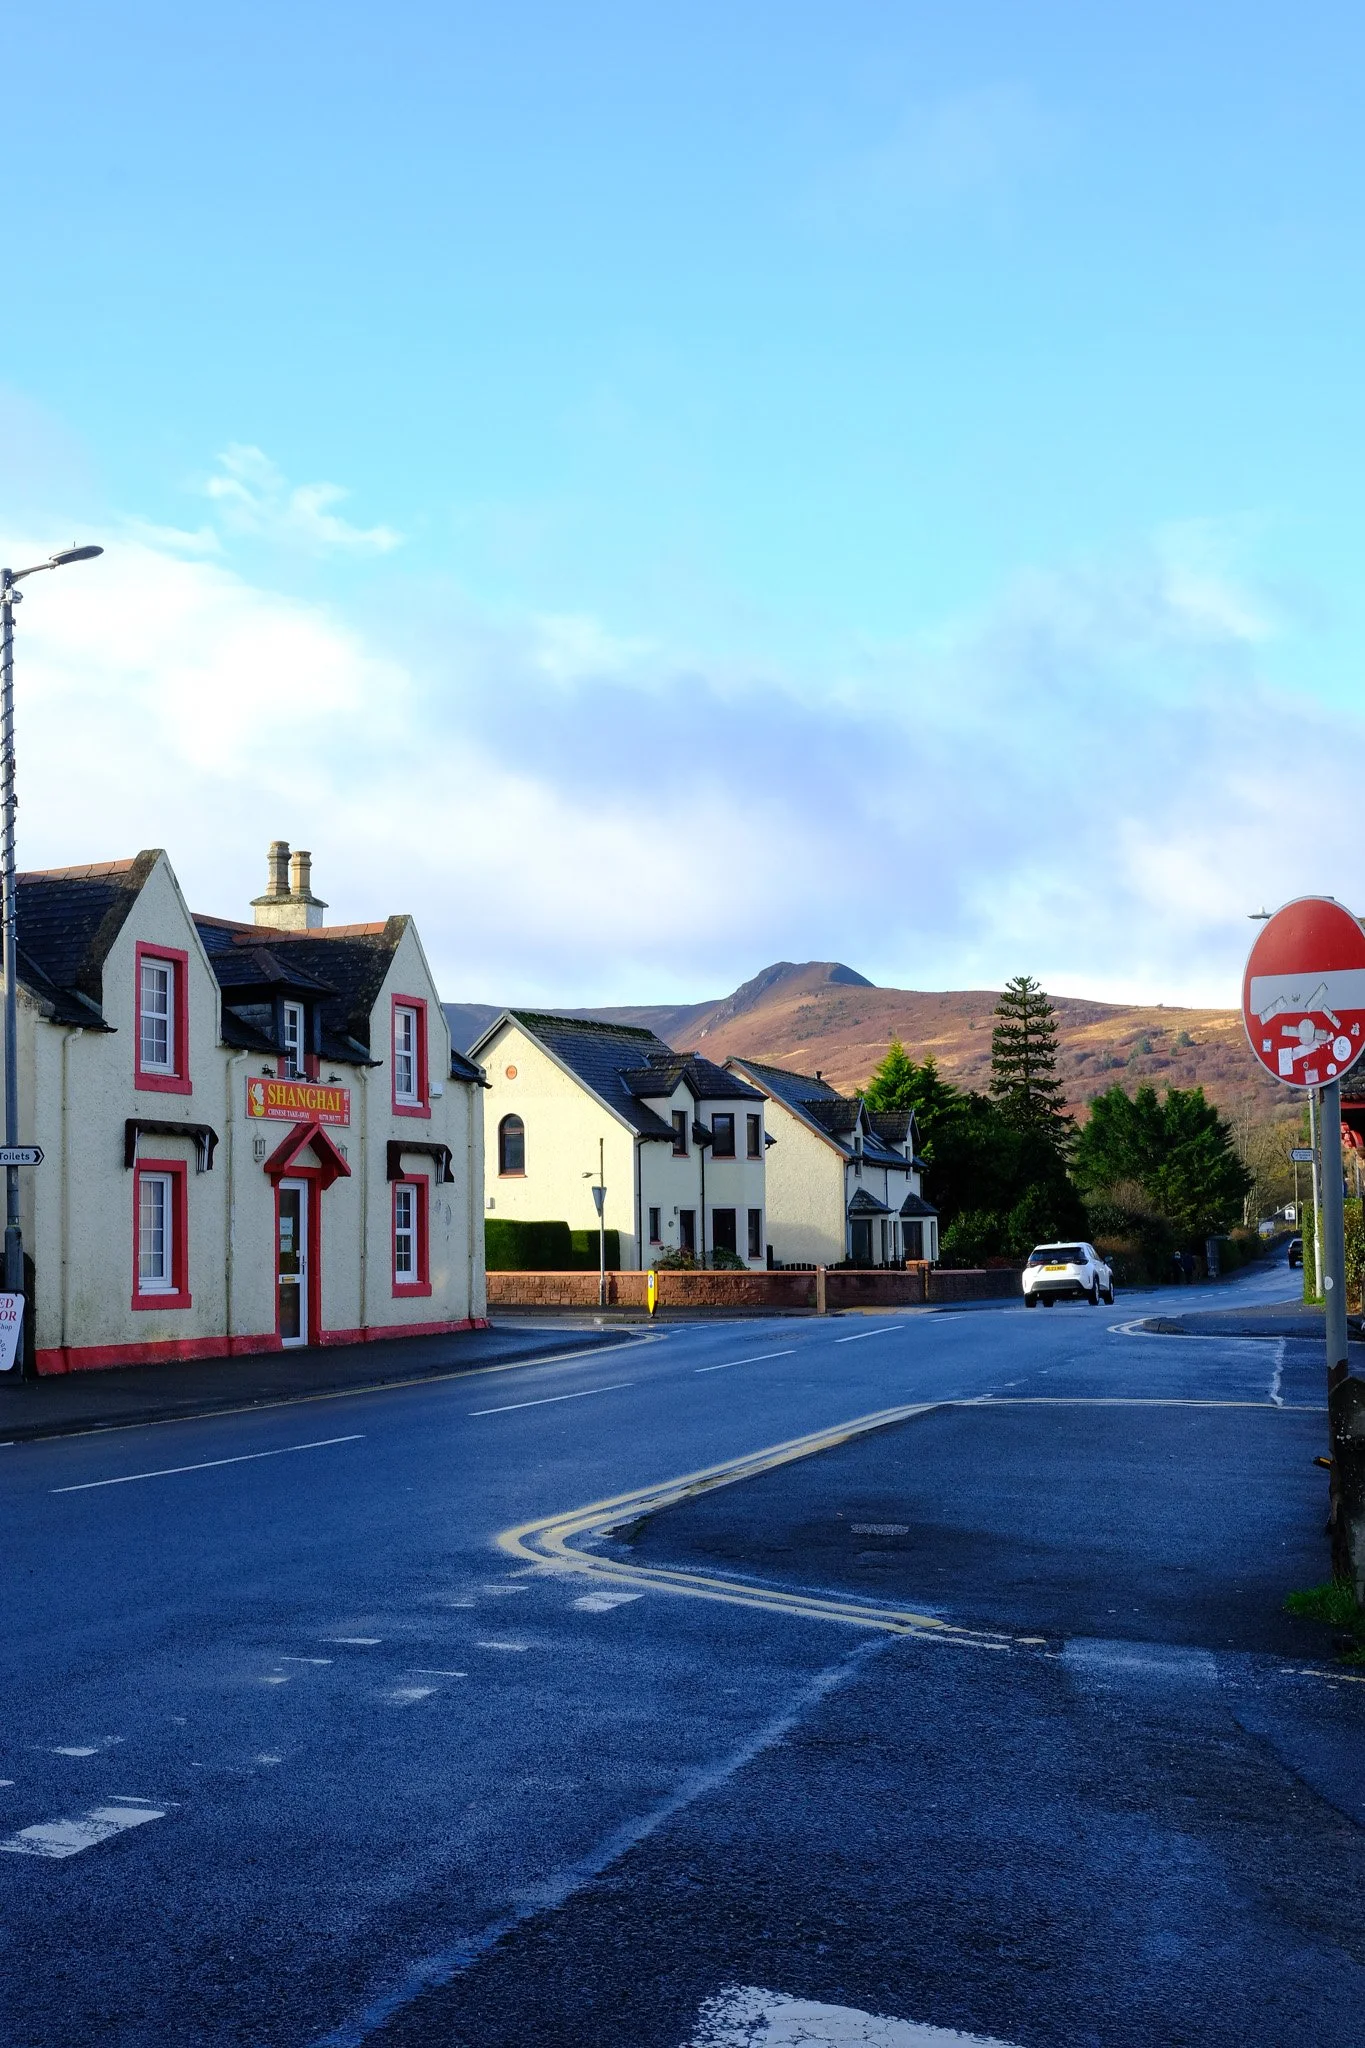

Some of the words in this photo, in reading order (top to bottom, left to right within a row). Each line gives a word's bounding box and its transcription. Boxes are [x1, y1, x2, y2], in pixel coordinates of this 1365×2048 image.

[268, 1083, 341, 1112] SHANGHAI
[0, 1152, 30, 1161] Toilets
[0, 1324, 13, 1332] hop
